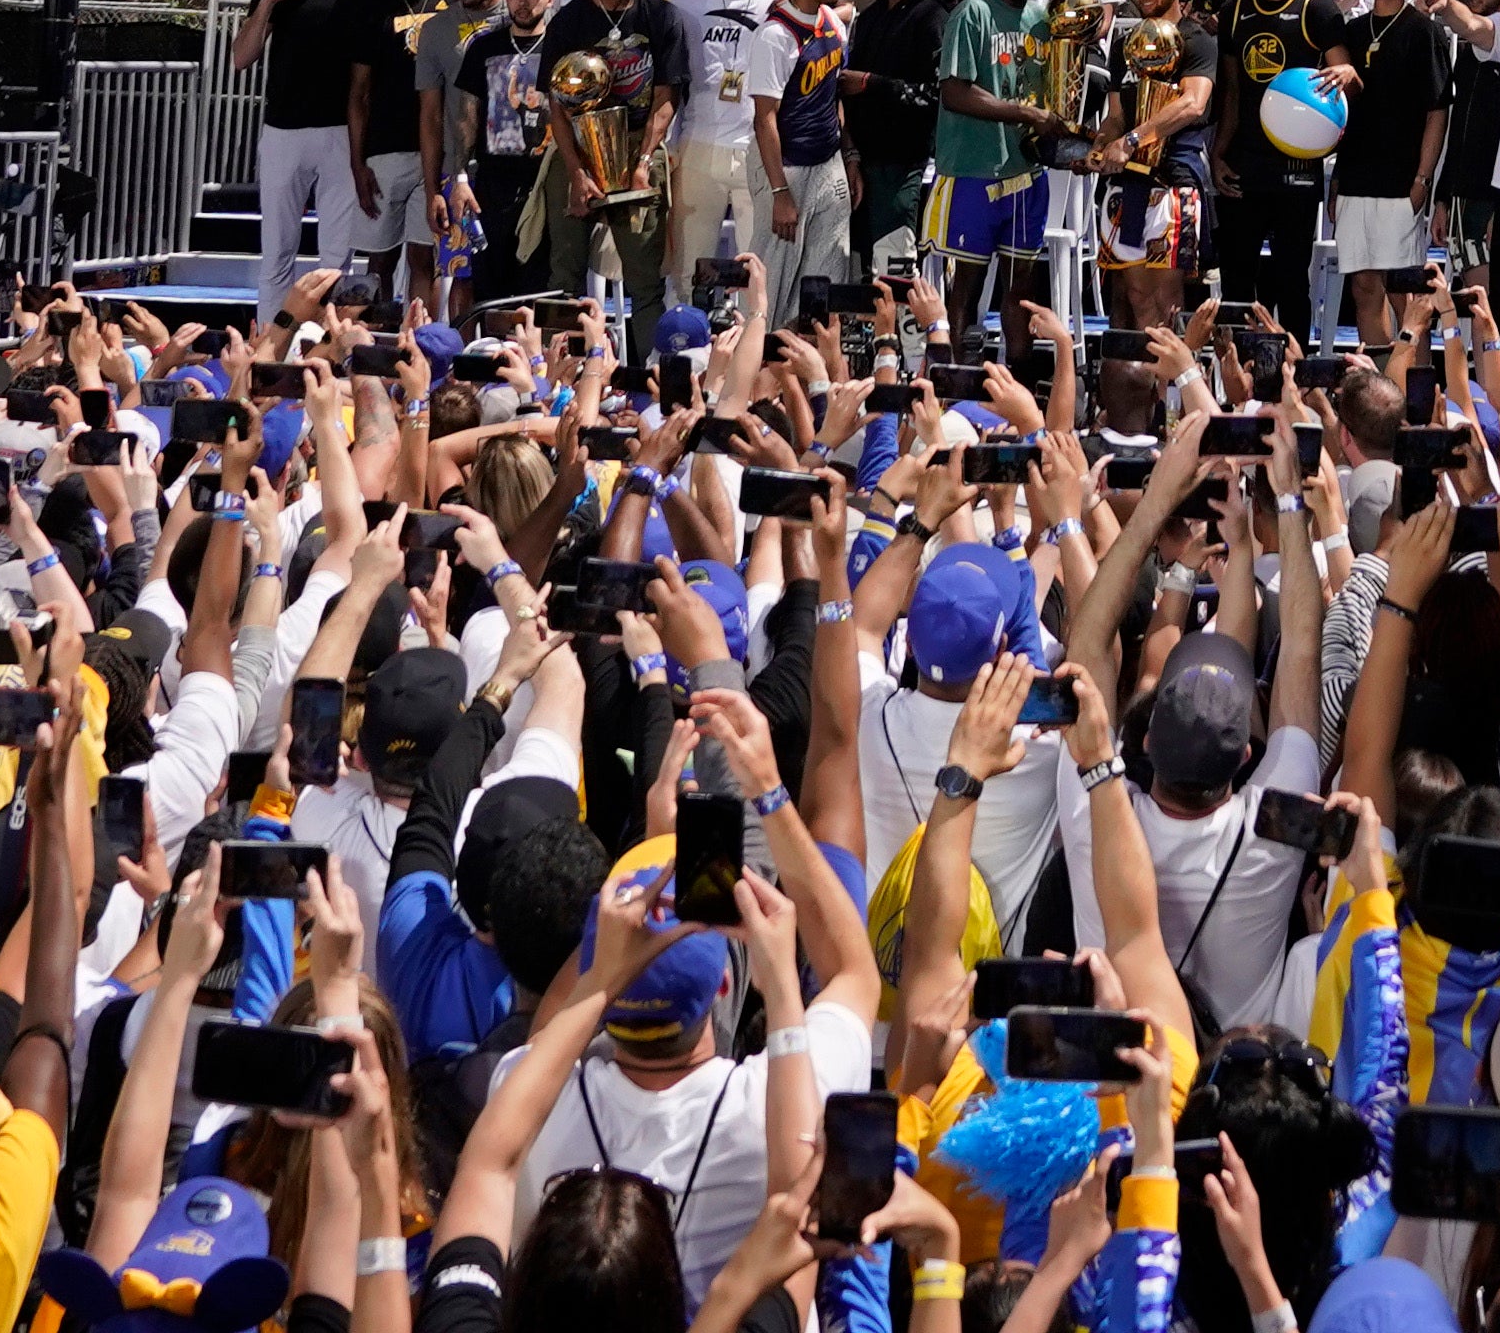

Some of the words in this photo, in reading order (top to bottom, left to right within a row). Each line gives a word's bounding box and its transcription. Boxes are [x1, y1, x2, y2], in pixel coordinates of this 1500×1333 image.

[703, 28, 741, 43] ANTA
[1258, 39, 1277, 54] 32
[8, 785, 27, 831] EOS
